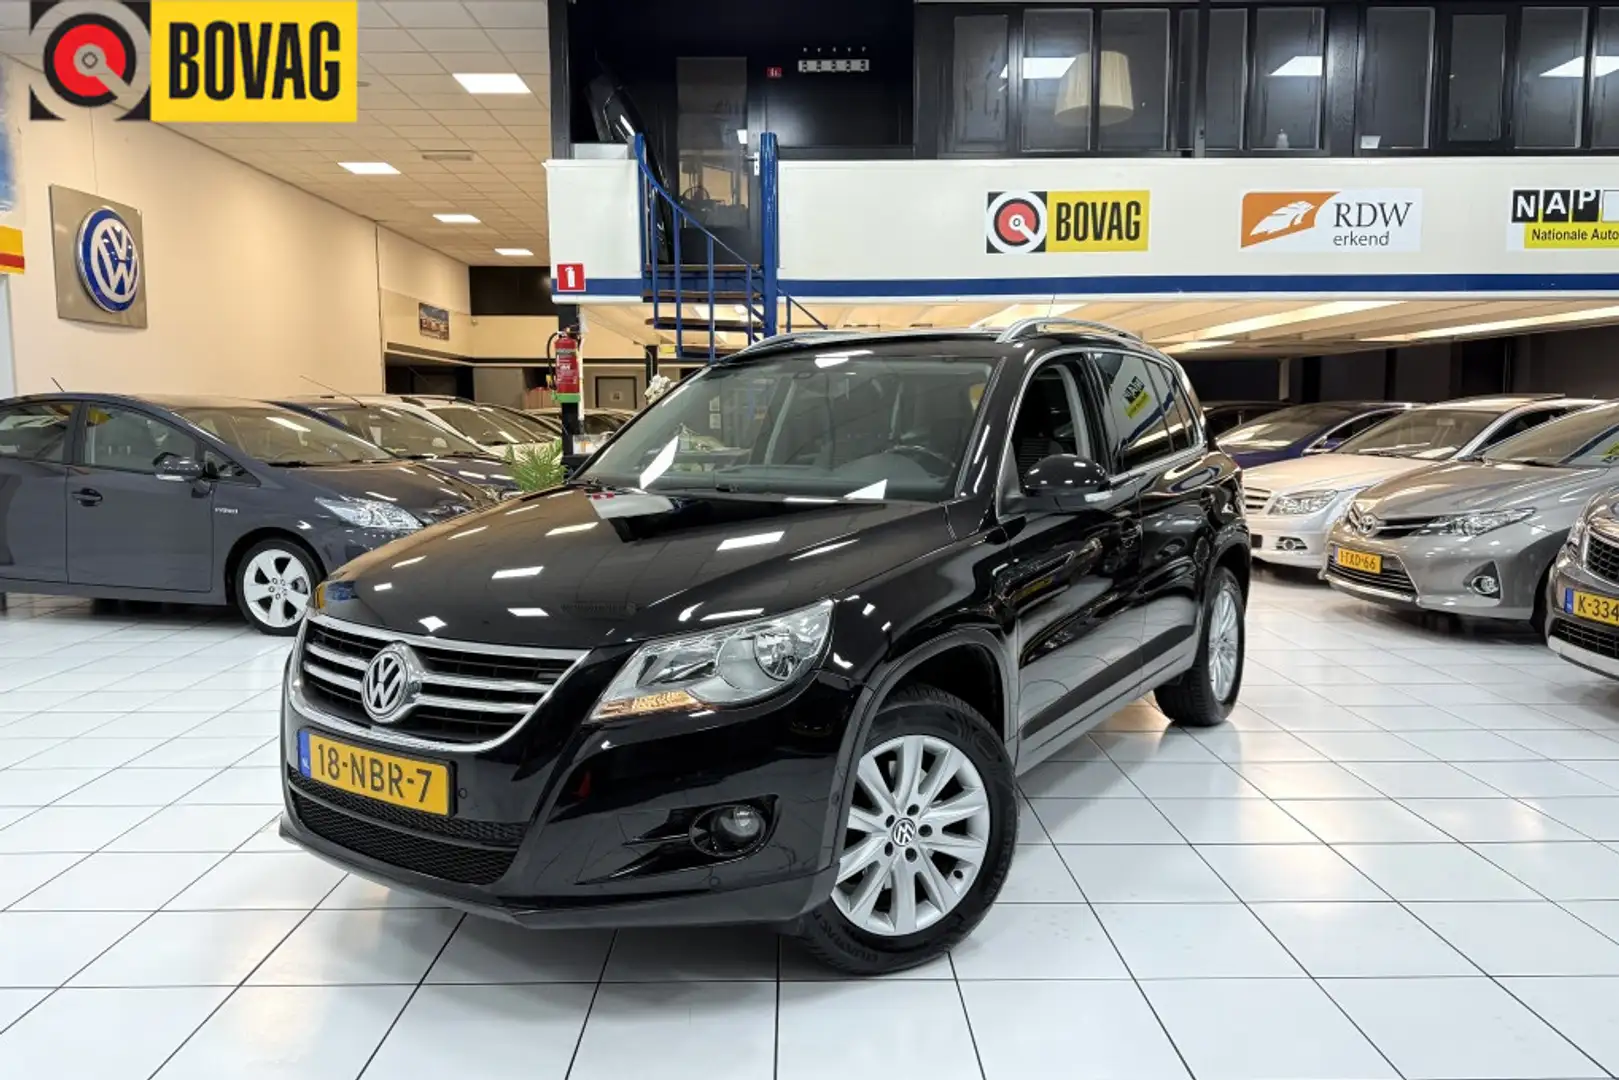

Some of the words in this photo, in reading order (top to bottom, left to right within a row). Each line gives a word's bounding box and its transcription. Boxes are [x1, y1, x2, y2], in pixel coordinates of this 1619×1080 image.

[1332, 202, 1413, 228] RDW
[1515, 188, 1597, 218] NAP
[1056, 200, 1142, 241] BOVAG
[1531, 228, 1588, 241] Nationale
[1333, 230, 1390, 246] erkend
[318, 743, 432, 803] 18-NBR-7
